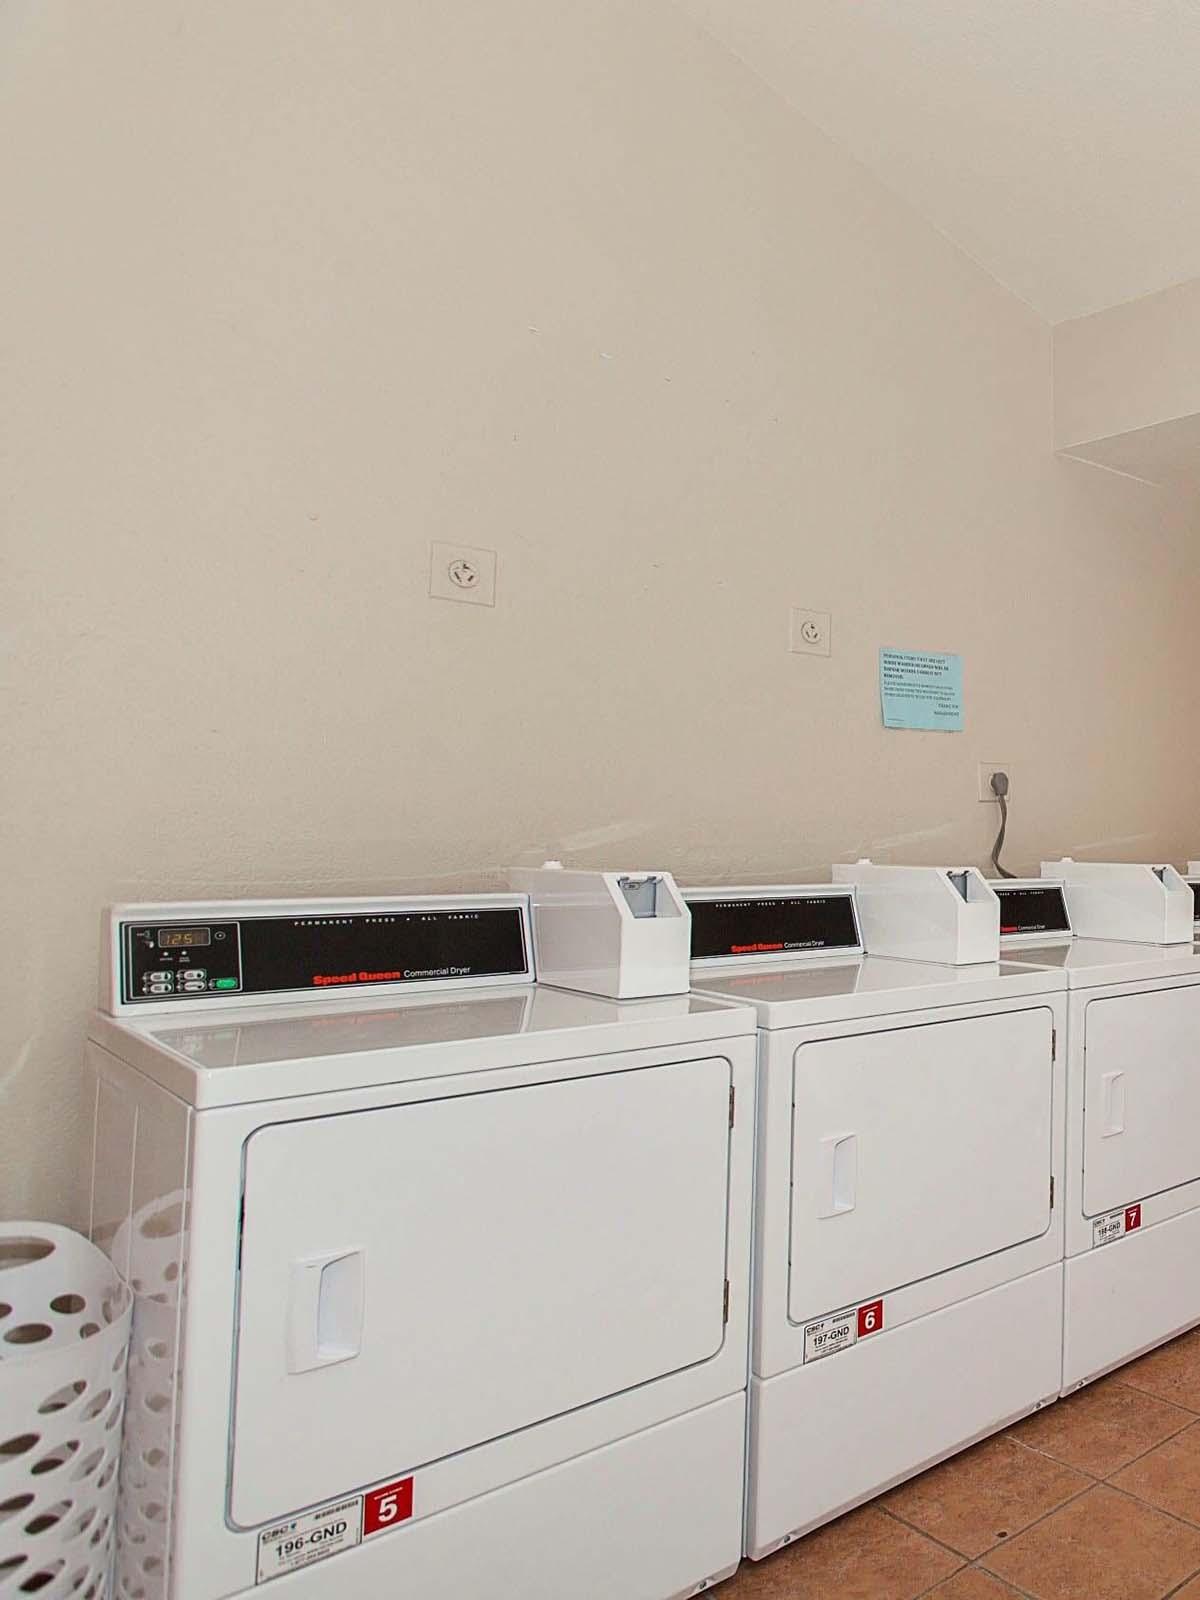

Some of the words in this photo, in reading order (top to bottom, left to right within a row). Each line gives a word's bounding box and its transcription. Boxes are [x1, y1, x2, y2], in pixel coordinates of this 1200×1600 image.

[313, 973, 357, 986] Speed
[358, 970, 400, 982] Queen
[403, 968, 449, 978] Commercial
[450, 966, 471, 976] Dryer
[1129, 1212, 1137, 1227] 7
[864, 1311, 876, 1329] 6
[813, 1326, 850, 1346] 197-GND
[377, 1494, 398, 1522] 5
[275, 1521, 347, 1557] 196-GND
